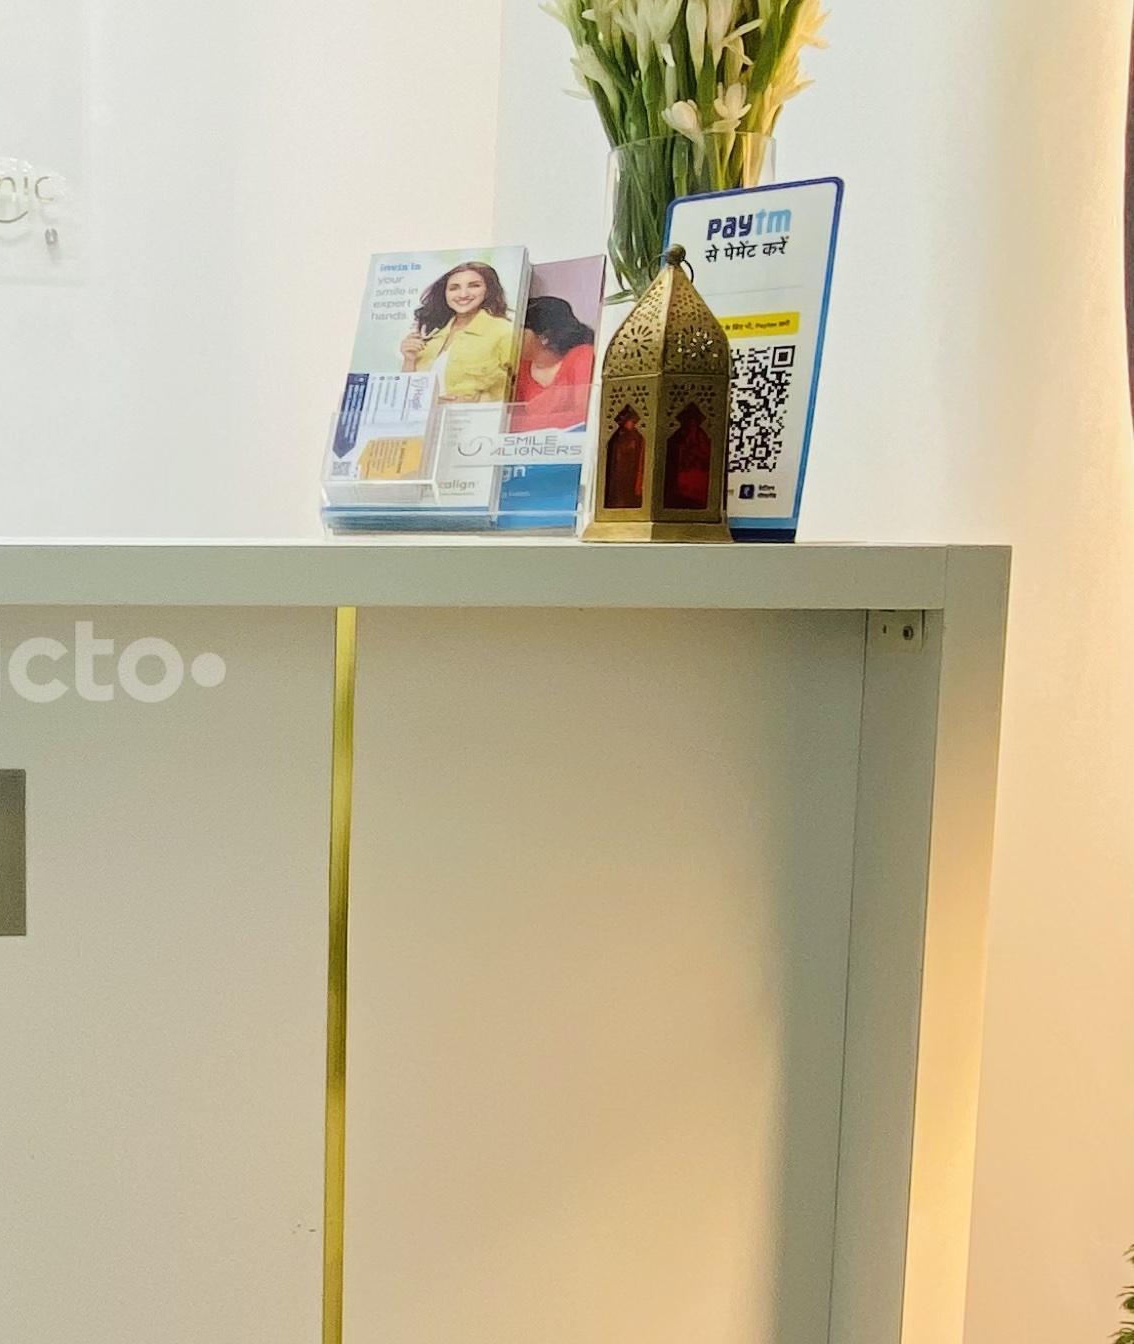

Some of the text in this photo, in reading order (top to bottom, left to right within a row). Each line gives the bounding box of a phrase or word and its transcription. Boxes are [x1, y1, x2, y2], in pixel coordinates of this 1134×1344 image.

[705, 235, 790, 263] से पेमेंट करें
[377, 276, 405, 286] your
[375, 287, 419, 297] smile in
[372, 299, 411, 309] expert
[503, 435, 558, 446] SMILE
[490, 445, 583, 456] ALIGNERS
